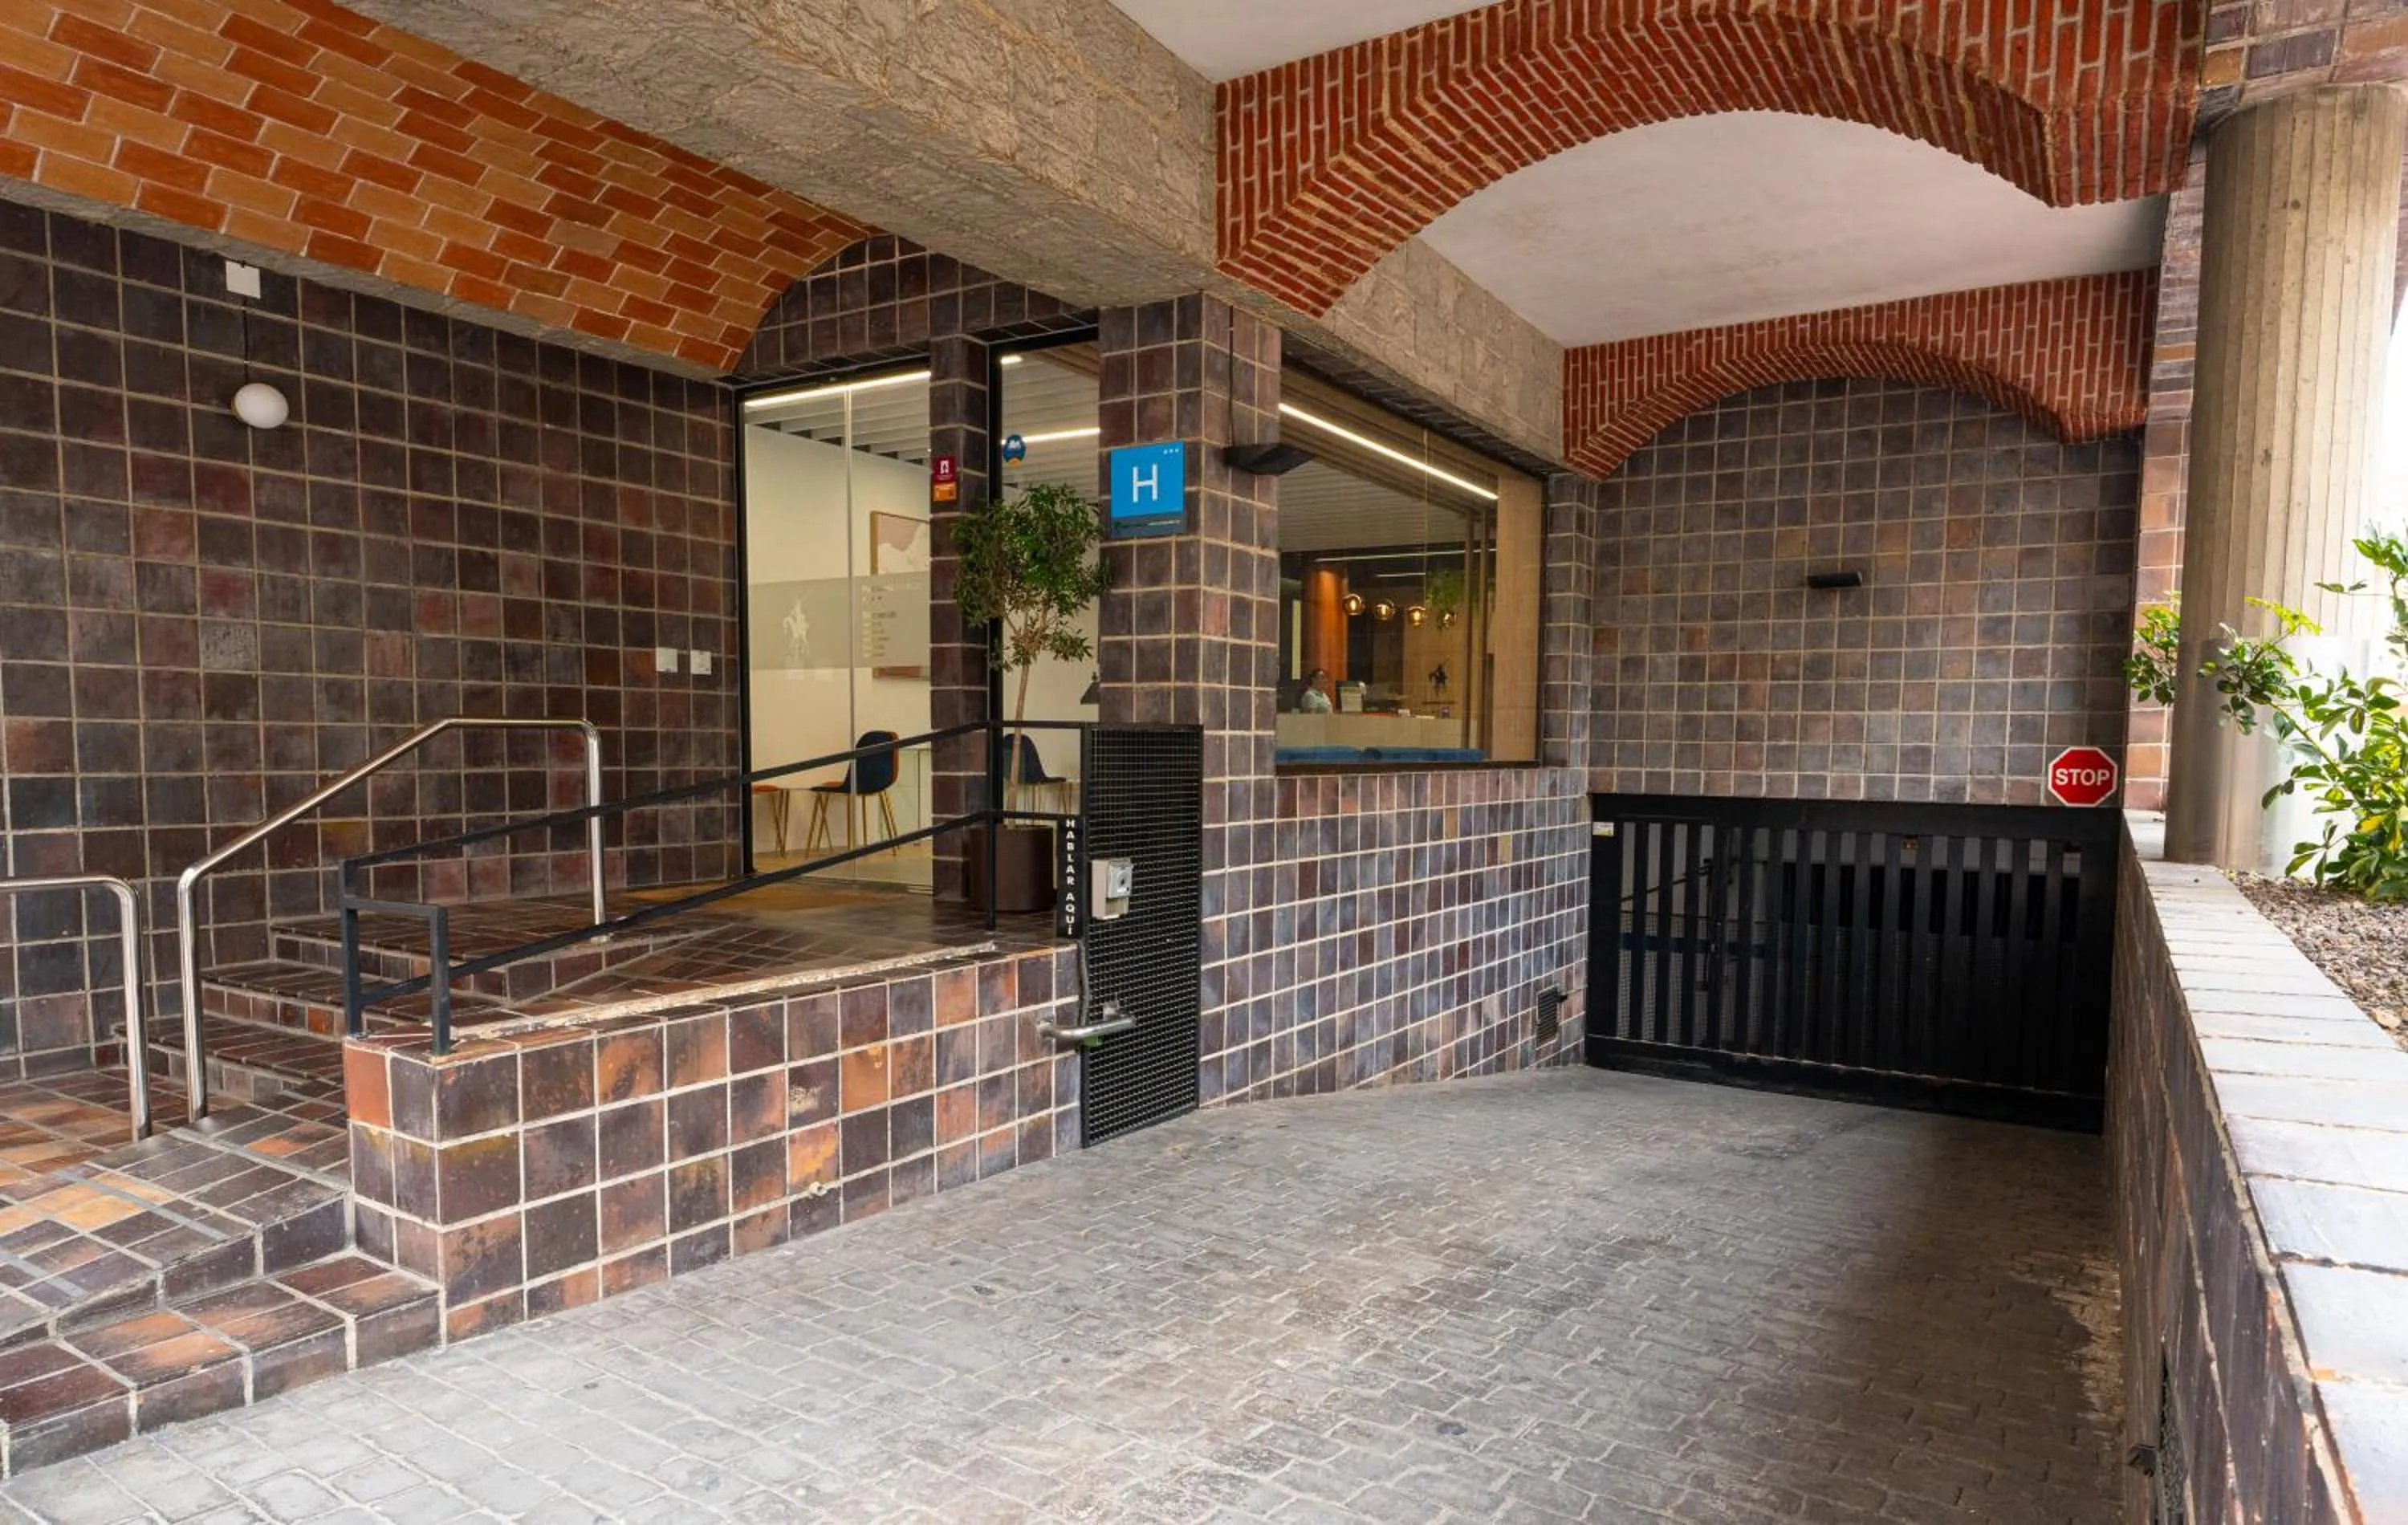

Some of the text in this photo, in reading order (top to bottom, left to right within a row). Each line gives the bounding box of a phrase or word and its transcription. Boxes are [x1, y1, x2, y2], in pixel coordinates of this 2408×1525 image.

[1133, 464, 1158, 503] H
[2055, 768, 2110, 786] STOP
[1065, 819, 1076, 885] HABLAR
